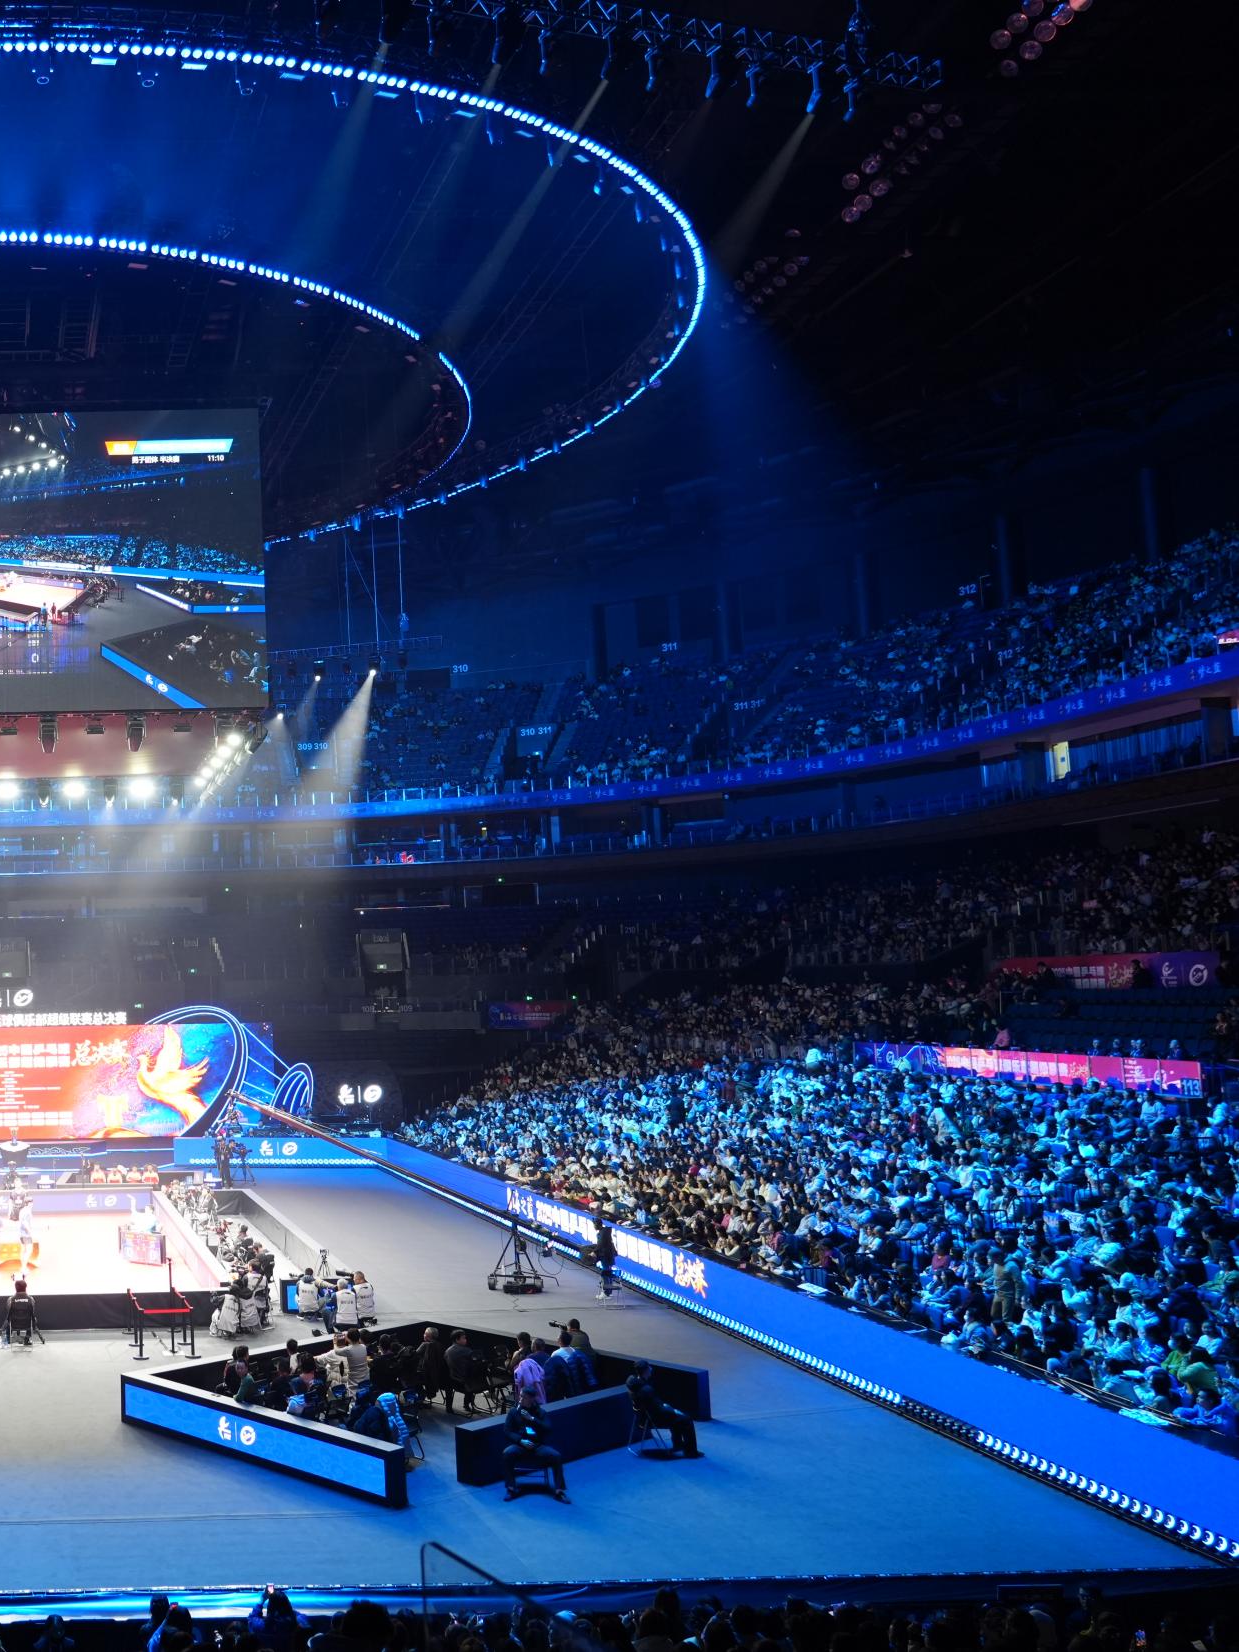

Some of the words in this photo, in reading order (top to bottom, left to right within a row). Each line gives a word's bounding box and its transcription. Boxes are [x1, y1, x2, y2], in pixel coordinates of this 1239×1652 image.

[208, 454, 225, 462] 11:10
[958, 584, 977, 596] 312
[661, 642, 678, 652] 311
[452, 664, 469, 673] 310
[734, 702, 748, 711] 311
[521, 728, 535, 736] 310
[538, 726, 552, 735] 311
[314, 742, 328, 750] 310
[1182, 1079, 1201, 1096] 113
